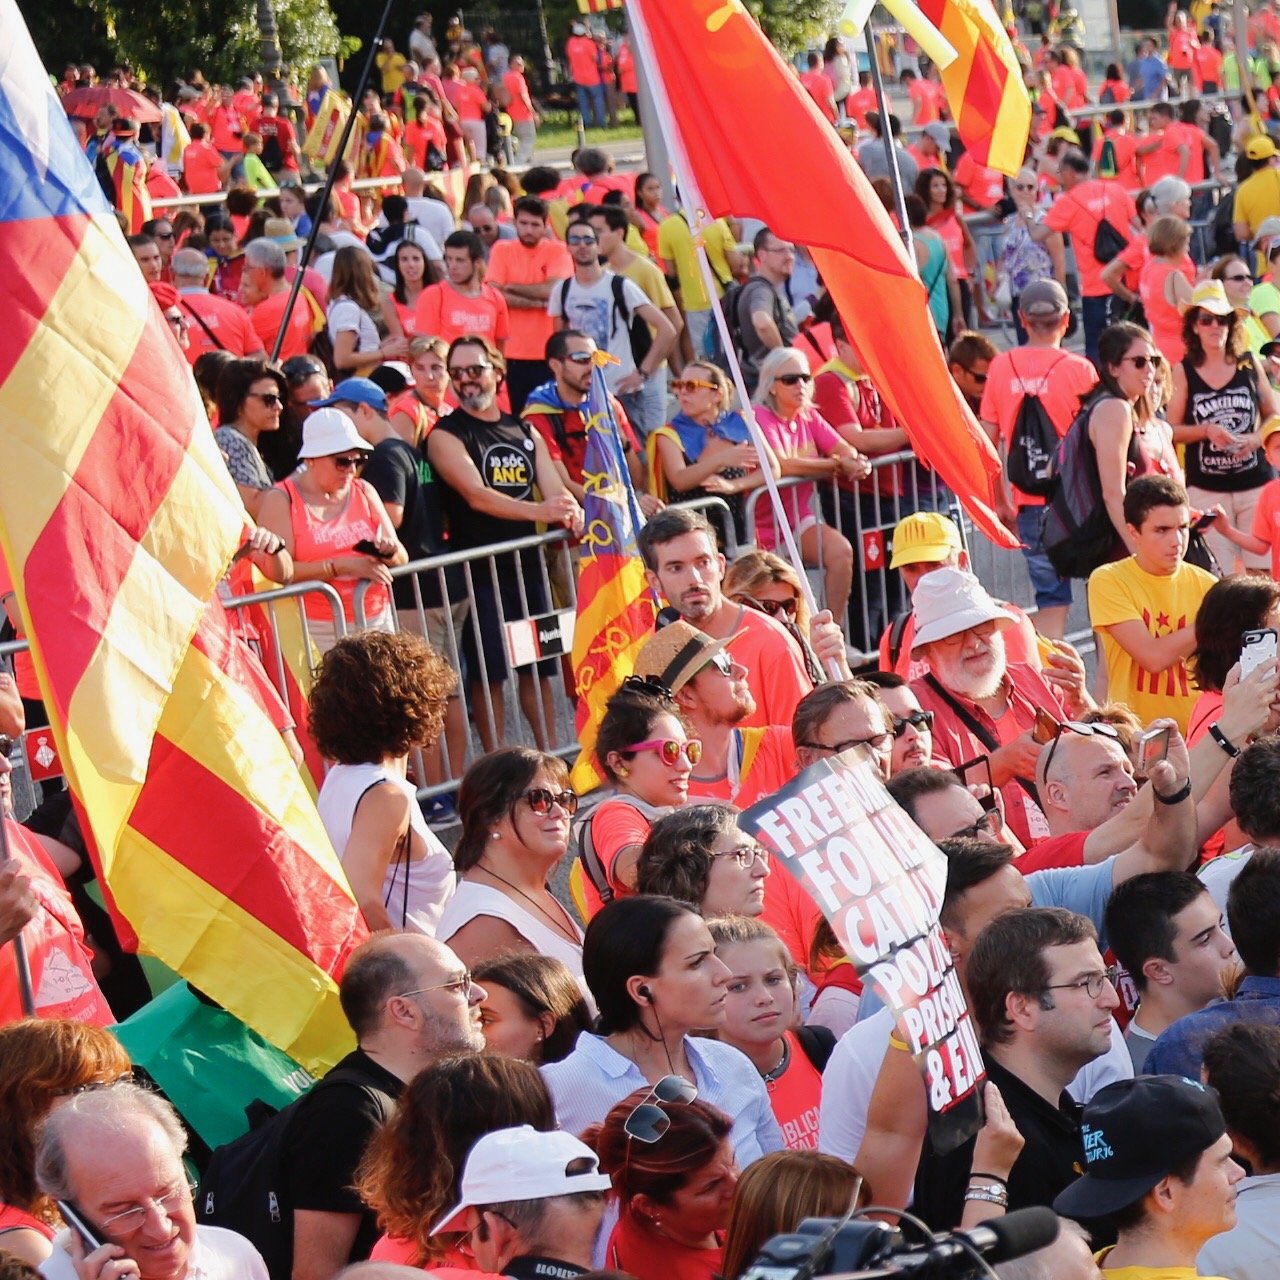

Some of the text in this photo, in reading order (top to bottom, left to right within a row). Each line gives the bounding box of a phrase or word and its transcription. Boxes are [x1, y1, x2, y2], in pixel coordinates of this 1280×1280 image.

[1197, 396, 1252, 418] BARCELONA
[493, 467, 526, 483] ANC
[927, 1054, 959, 1112] &
[535, 1263, 582, 1280] anon
